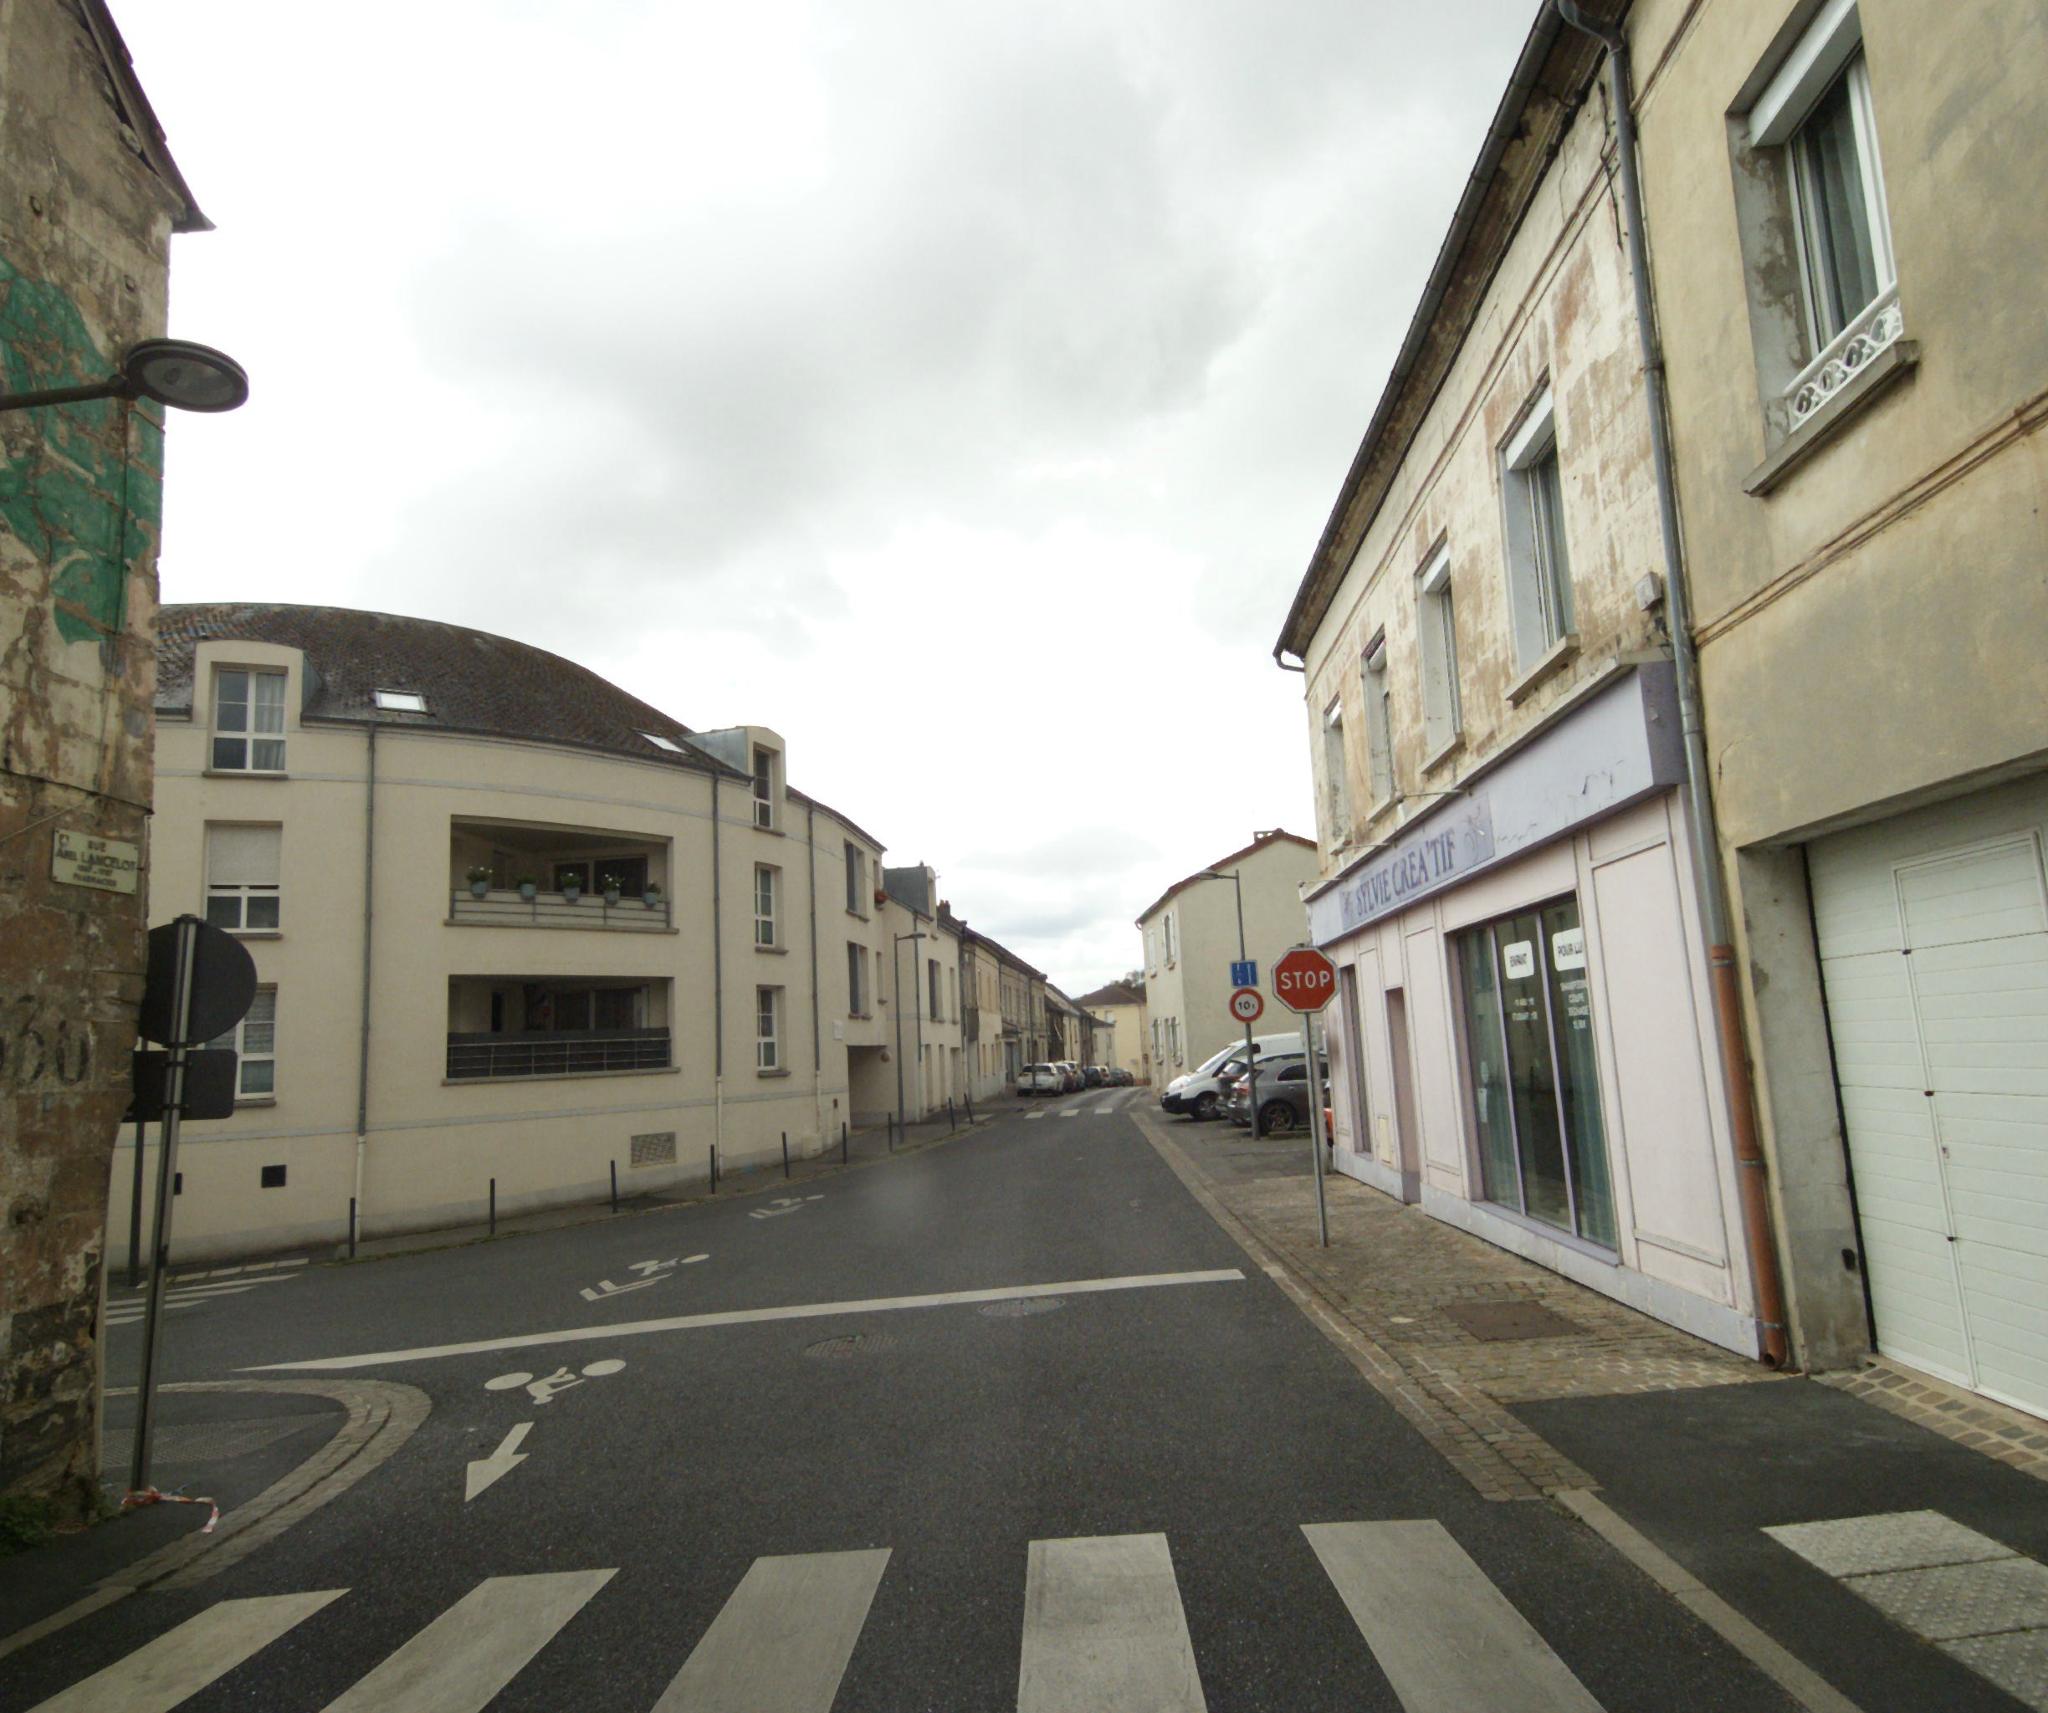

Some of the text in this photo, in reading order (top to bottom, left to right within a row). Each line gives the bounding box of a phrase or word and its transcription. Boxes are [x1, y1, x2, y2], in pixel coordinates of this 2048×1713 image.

[88, 840, 107, 853] RUE
[81, 851, 136, 871] LANCELOT
[1356, 868, 1391, 916] SYLVIE
[1281, 970, 1330, 989] STOP
